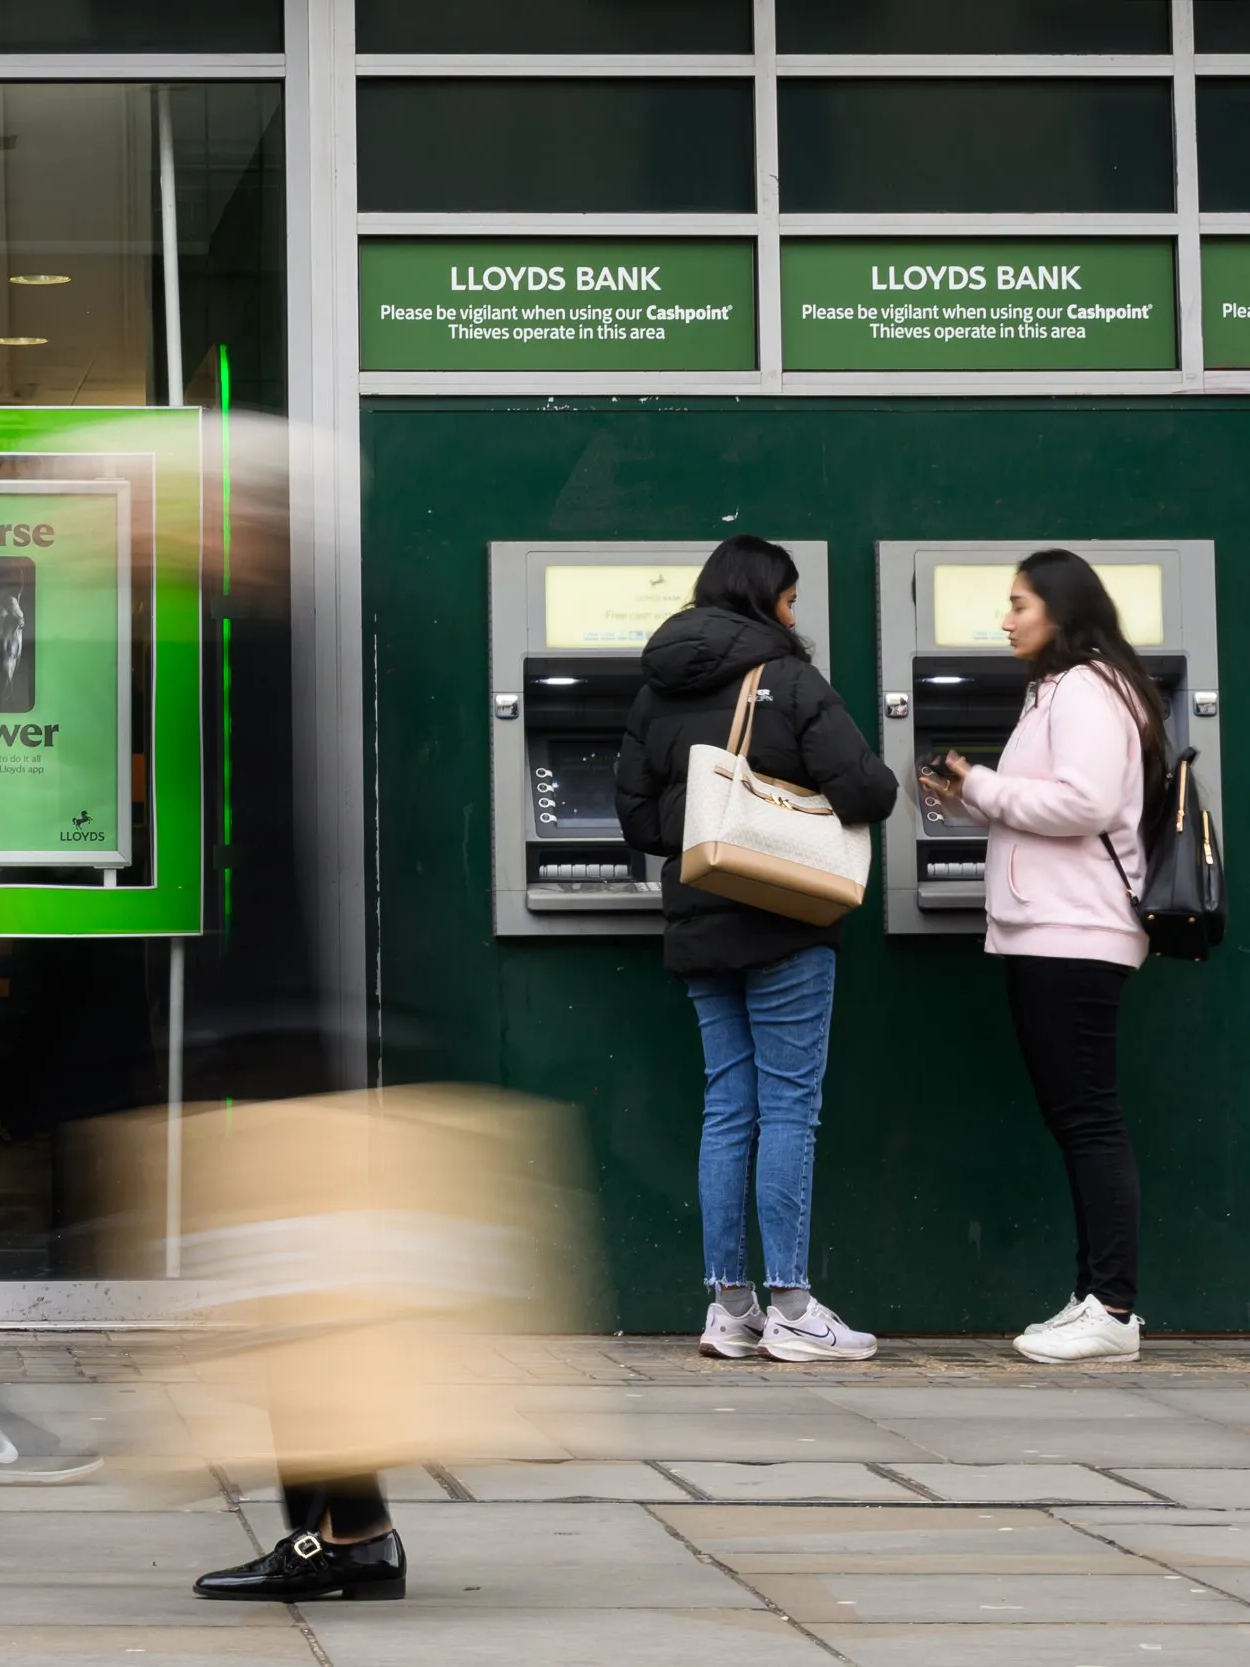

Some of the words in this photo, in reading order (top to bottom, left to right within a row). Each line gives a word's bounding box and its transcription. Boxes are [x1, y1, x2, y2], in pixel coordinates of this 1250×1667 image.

[451, 267, 565, 291] LLOYDS
[577, 267, 661, 291] BANK
[871, 266, 986, 290] LLOYDS
[997, 266, 1081, 290] BANK
[380, 304, 432, 320] Please
[436, 304, 457, 320] be
[460, 304, 518, 324] vigilant
[522, 304, 565, 320] when
[569, 304, 612, 324] using
[616, 308, 642, 320] our
[802, 303, 854, 319] Please
[858, 303, 877, 319] be
[881, 303, 939, 323] vigilant
[942, 303, 986, 319] when
[990, 303, 1033, 323] using
[1036, 307, 1063, 319] our
[448, 324, 509, 340] Thieves
[513, 325, 575, 343] operate
[579, 324, 593, 340] in
[597, 324, 626, 340] this
[630, 328, 665, 340] area
[870, 323, 930, 339] Thieves
[934, 324, 996, 342] operate
[1000, 323, 1014, 339] in
[1018, 323, 1047, 339] this
[1051, 327, 1086, 339] area
[10, 754, 22, 763] do
[23, 754, 30, 763] it
[31, 754, 42, 763] all
[0, 765, 26, 775] Lloyds
[28, 766, 44, 775] app
[60, 831, 105, 842] LLOYDS
